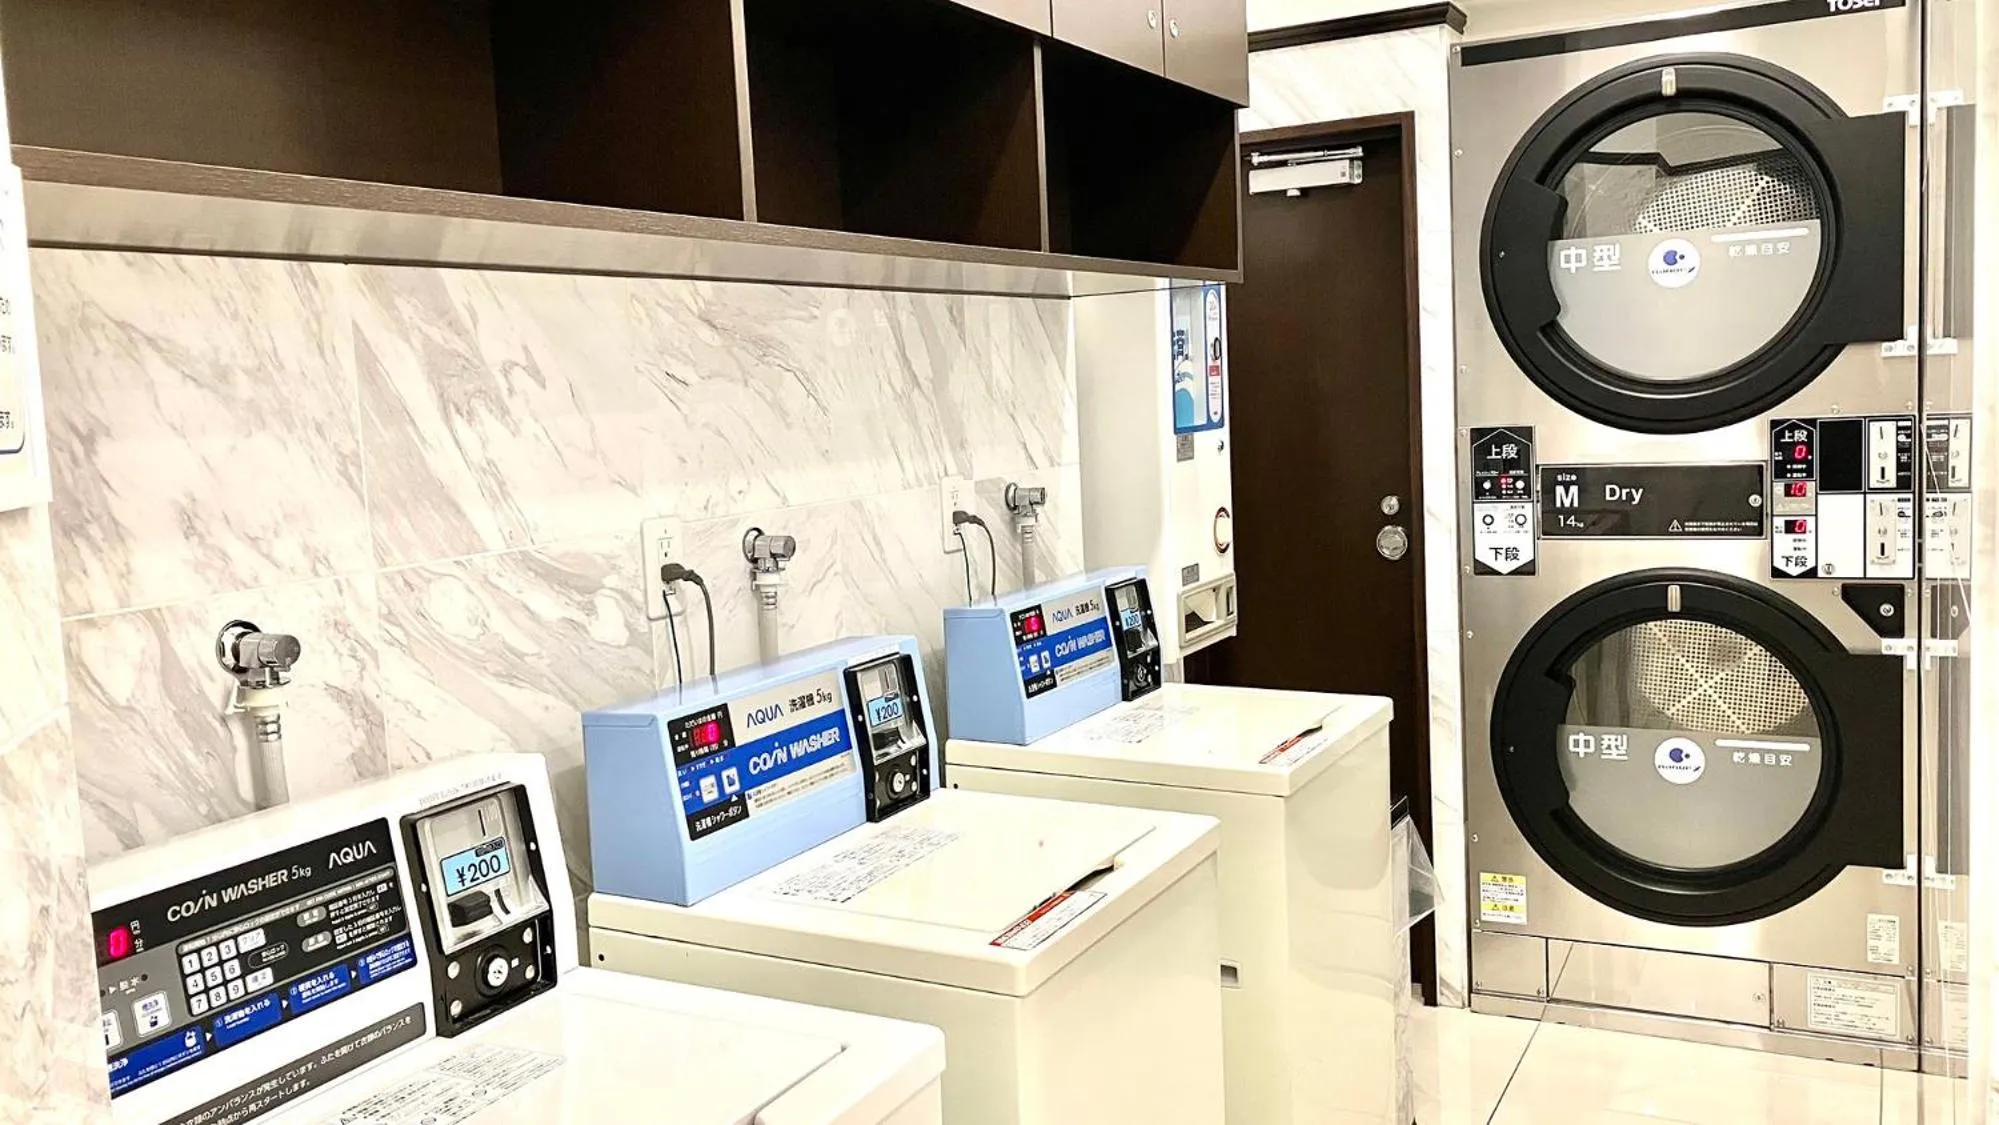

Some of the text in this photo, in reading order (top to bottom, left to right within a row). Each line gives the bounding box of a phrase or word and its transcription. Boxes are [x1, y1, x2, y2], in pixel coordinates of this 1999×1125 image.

[1559, 243, 1622, 273] 中型
[1780, 429, 1808, 442] 上段
[1486, 444, 1518, 460] 上段
[1794, 445, 1807, 460] 0
[1556, 472, 1578, 481] size
[1555, 485, 1579, 508] M
[1605, 484, 1644, 505] Dry
[1790, 482, 1807, 497] 10
[1794, 519, 1806, 534] 0
[1489, 546, 1521, 562] 下段
[1781, 555, 1808, 568] 下段
[746, 702, 783, 729] AQUA
[816, 688, 833, 704] 5kg
[875, 702, 899, 722] ¥200
[748, 741, 788, 776] COIN
[789, 726, 841, 759] WASHER
[1568, 731, 1629, 761] 中型
[456, 854, 501, 887] ¥200
[166, 887, 219, 923] COIN
[221, 869, 289, 905] WASHER
[290, 864, 313, 880] 5kg
[328, 840, 377, 869] AQUA
[206, 951, 214, 962] 2
[225, 944, 232, 954] 3
[188, 959, 194, 968] 1
[228, 964, 236, 975] 6
[192, 978, 198, 989] 4
[210, 971, 218, 982] 5
[215, 991, 222, 1002] 8
[232, 984, 240, 995] 9
[195, 999, 202, 1009] 7
